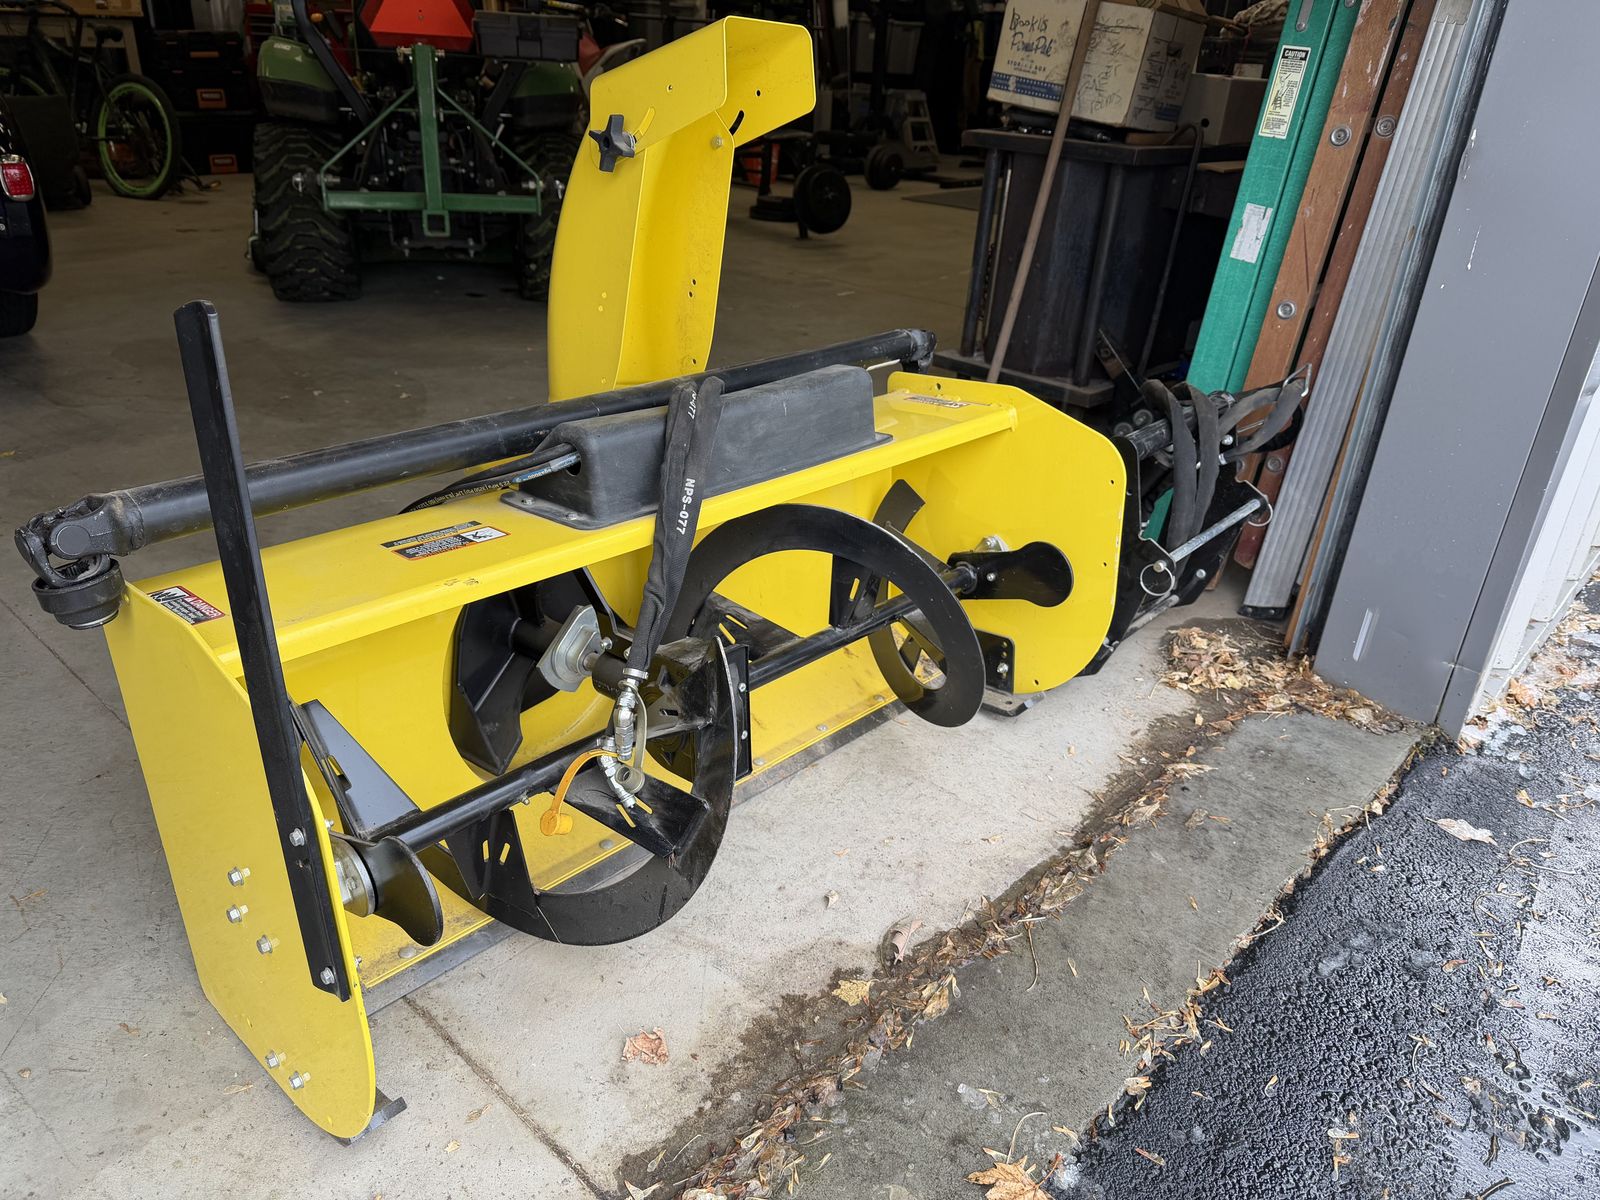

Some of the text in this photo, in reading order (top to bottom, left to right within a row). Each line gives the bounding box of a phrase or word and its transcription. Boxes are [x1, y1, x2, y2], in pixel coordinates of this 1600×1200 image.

[1285, 50, 1306, 58] CAUTION
[676, 478, 695, 534] NPS-077
[189, 598, 222, 618] DANGER
